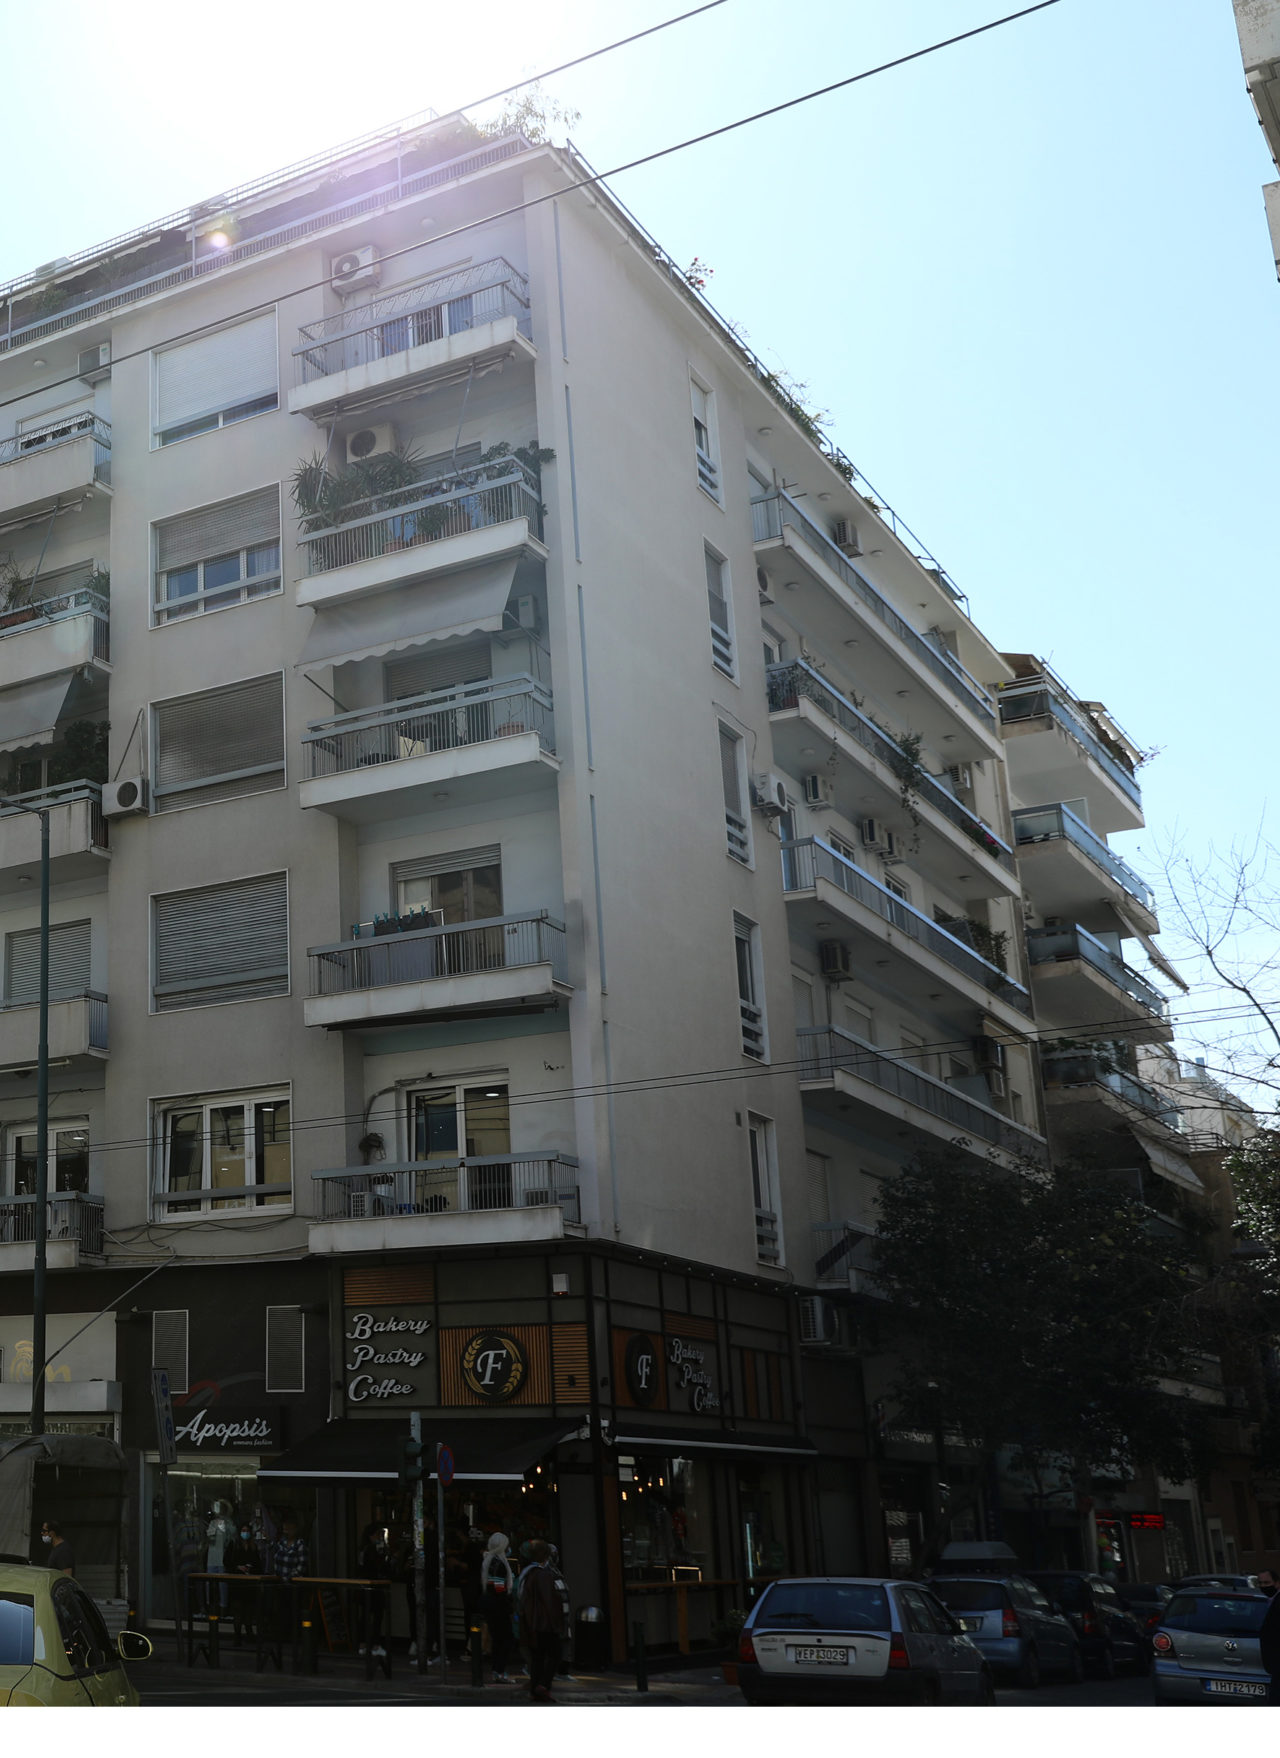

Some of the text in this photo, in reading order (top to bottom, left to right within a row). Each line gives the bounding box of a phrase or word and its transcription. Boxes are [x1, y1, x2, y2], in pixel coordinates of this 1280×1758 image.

[346, 1313, 432, 1340] Bakery
[346, 1344, 425, 1371] Pastry
[670, 1338, 705, 1364] Bakery
[476, 1349, 507, 1385] F
[638, 1354, 652, 1389] F
[681, 1363, 712, 1388] Pastry
[348, 1374, 414, 1402] Coffee
[694, 1386, 721, 1411] Coffee
[174, 1408, 272, 1446] Apopsis
